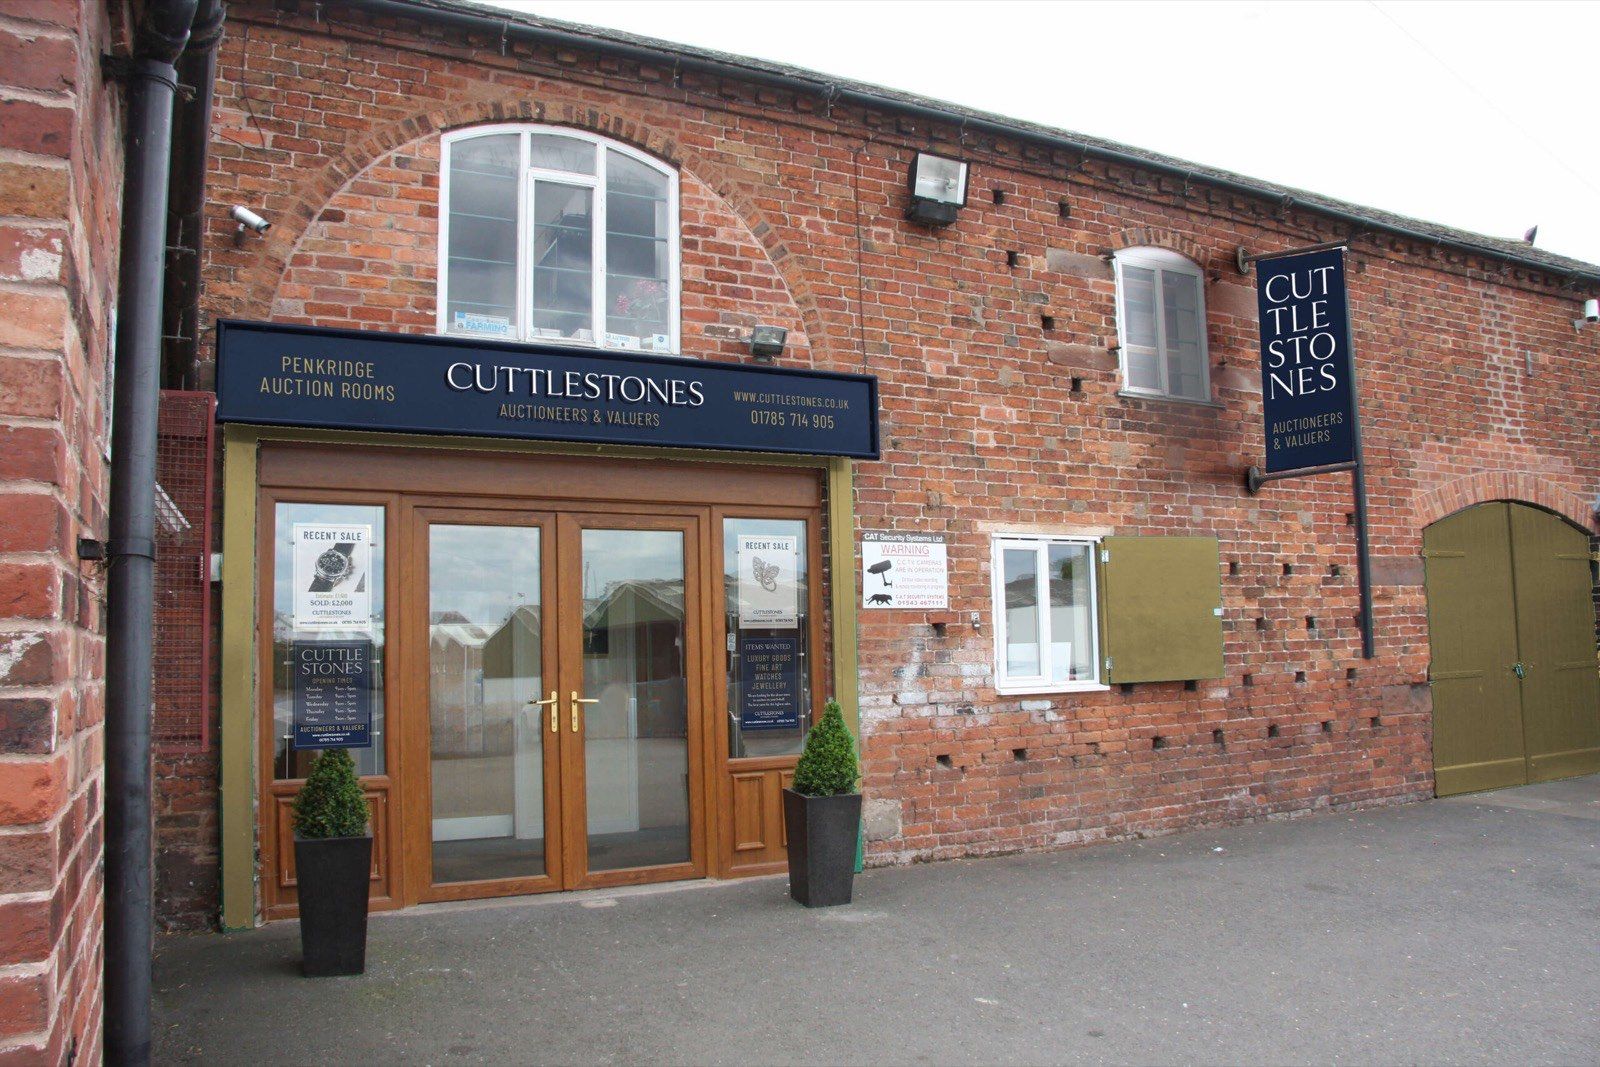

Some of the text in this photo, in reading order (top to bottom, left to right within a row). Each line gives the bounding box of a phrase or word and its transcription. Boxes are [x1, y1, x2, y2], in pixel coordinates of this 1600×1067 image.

[1265, 266, 1334, 304] CUT
[1266, 300, 1330, 336] TLE
[1268, 332, 1336, 368] STO
[282, 356, 375, 379] PENKRIDGE
[260, 377, 395, 402] AUCTION ROOMS
[447, 362, 704, 406] CUTTLESTONES
[1270, 363, 1337, 400] NES
[734, 391, 850, 410] WWW.CUTTLESTONES.CO.UK
[500, 404, 660, 427] AUCTIONEERS & VALUERS
[750, 410, 834, 429] 01785 714 905
[1272, 412, 1343, 434] AUCTIONEERS
[1274, 430, 1331, 450] & VALUERS
[304, 531, 362, 541] RECENT SALE
[746, 542, 770, 550] RECENT
[880, 534, 904, 542] Security
[881, 544, 929, 554] WARNING
[302, 649, 362, 661] CUTTLE
[302, 662, 362, 675] STONES
